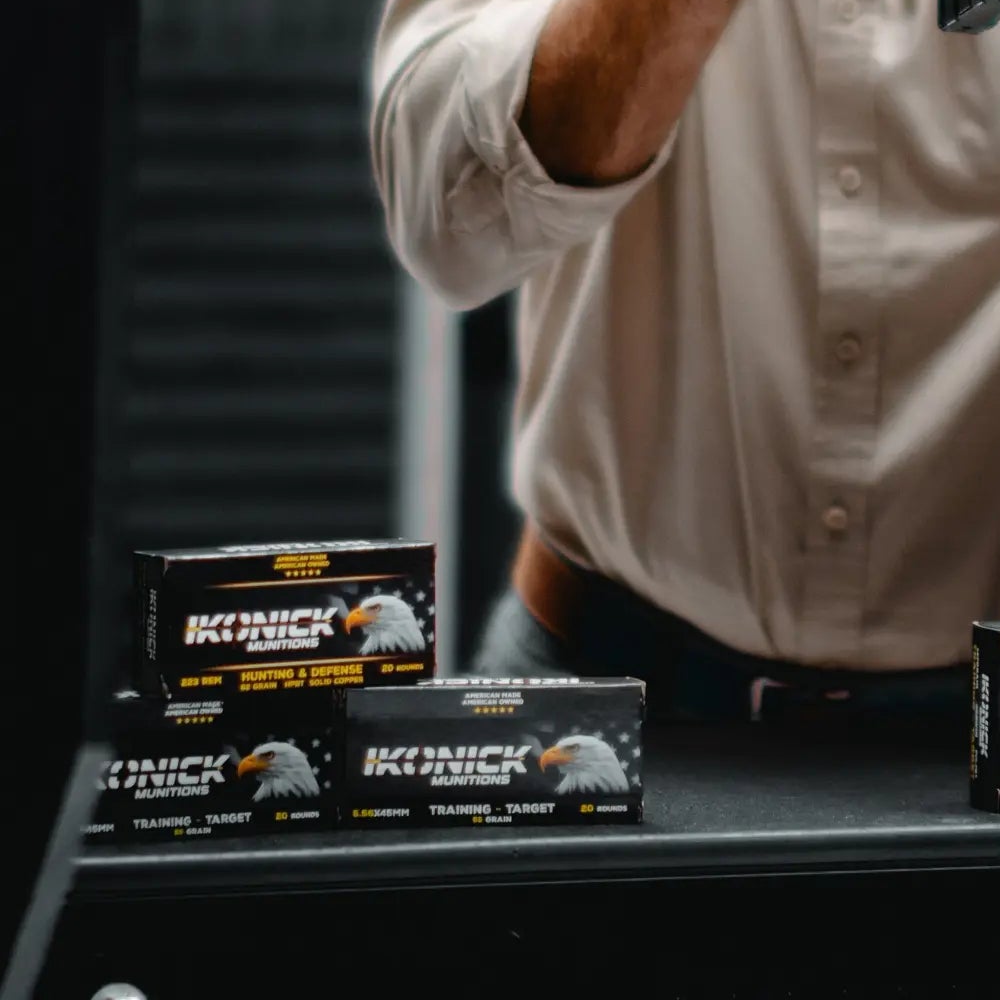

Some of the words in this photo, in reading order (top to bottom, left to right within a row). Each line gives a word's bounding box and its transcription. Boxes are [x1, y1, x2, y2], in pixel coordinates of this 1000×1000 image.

[184, 607, 338, 645] IKONICK
[246, 637, 320, 652] MUNITIONS
[241, 668, 294, 682] HUNTING
[298, 668, 307, 678] &
[311, 664, 363, 676] DEFENSE
[253, 681, 277, 690] GRAIN
[309, 679, 332, 687] SOLID
[334, 676, 364, 685] COPPER
[363, 745, 532, 776] IKONICK
[95, 753, 230, 790] ONICK
[431, 774, 510, 787] MUNITIONS
[134, 785, 210, 799] MUNITIONS
[290, 811, 320, 819] ROUNDS
[429, 805, 491, 816] TRAINING
[505, 803, 555, 814] TARGET
[580, 804, 594, 813] 20
[133, 815, 192, 830] TRAINING
[205, 812, 252, 825] TARGET
[485, 815, 512, 823] GRAIN
[186, 827, 211, 835] GRAIN
